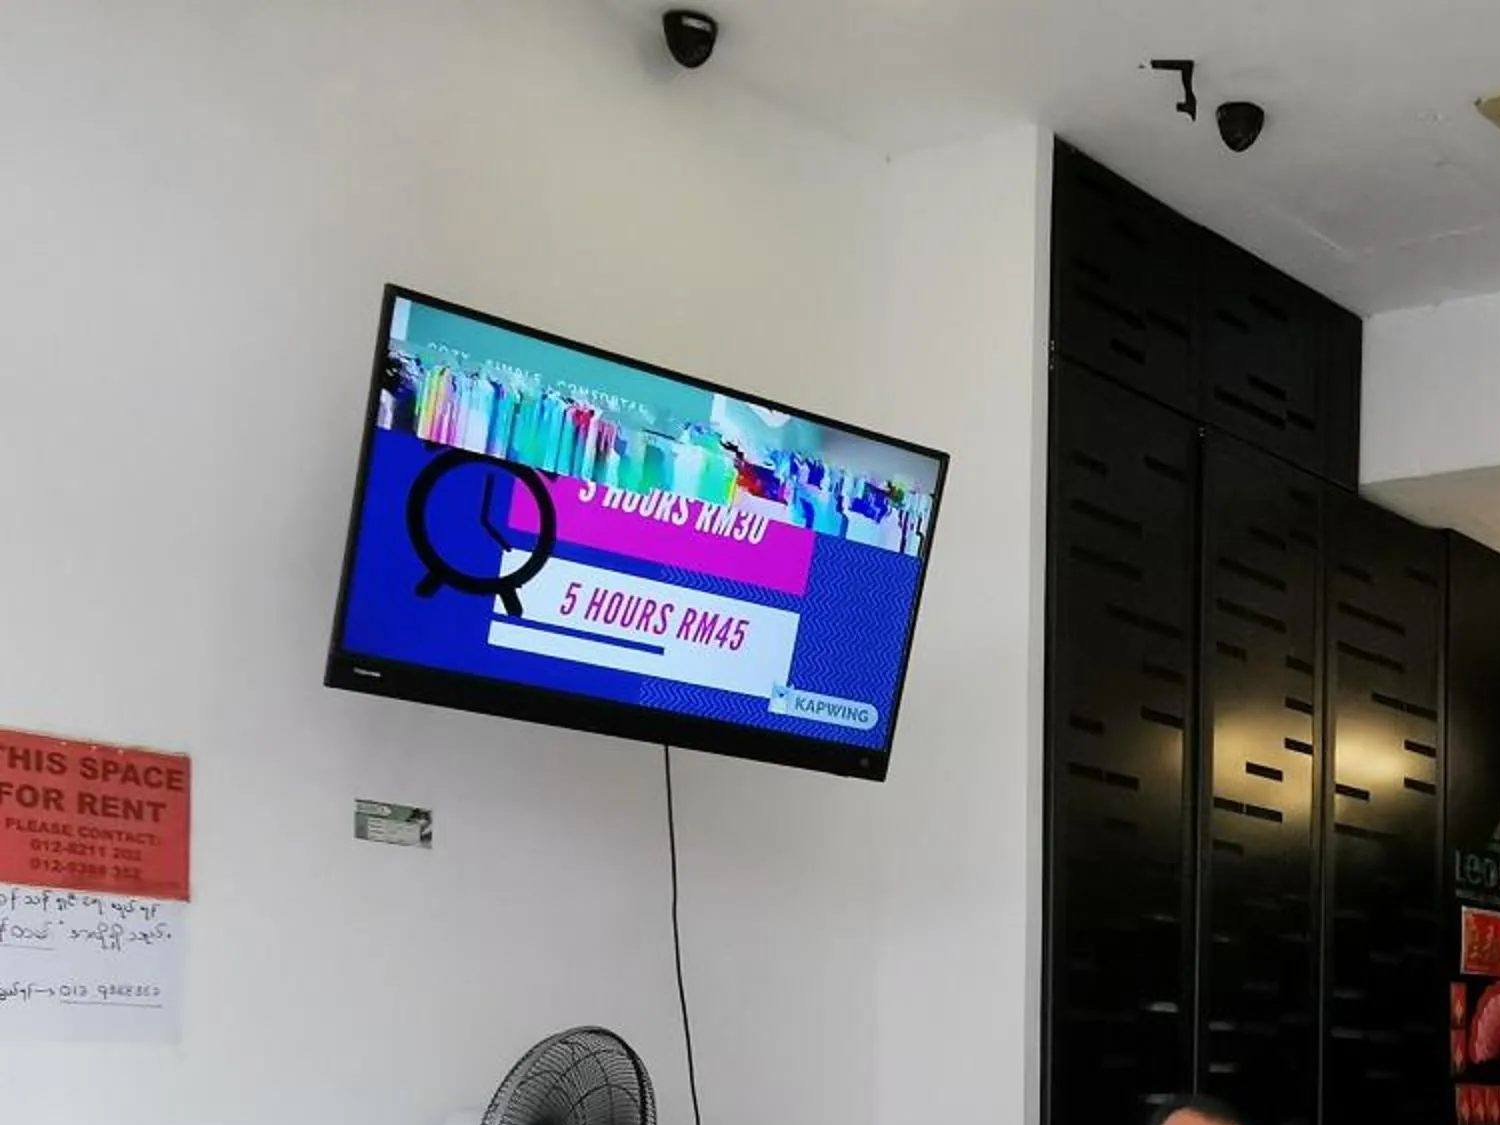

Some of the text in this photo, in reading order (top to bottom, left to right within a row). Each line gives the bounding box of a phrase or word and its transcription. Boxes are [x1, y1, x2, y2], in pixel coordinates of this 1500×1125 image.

[560, 582, 750, 651] 5 HOURS RM45
[795, 696, 869, 723] KAPWING
[0, 744, 184, 792] HIS SPACE
[0, 781, 166, 823] FOR RENT
[5, 817, 72, 836] PLEASE
